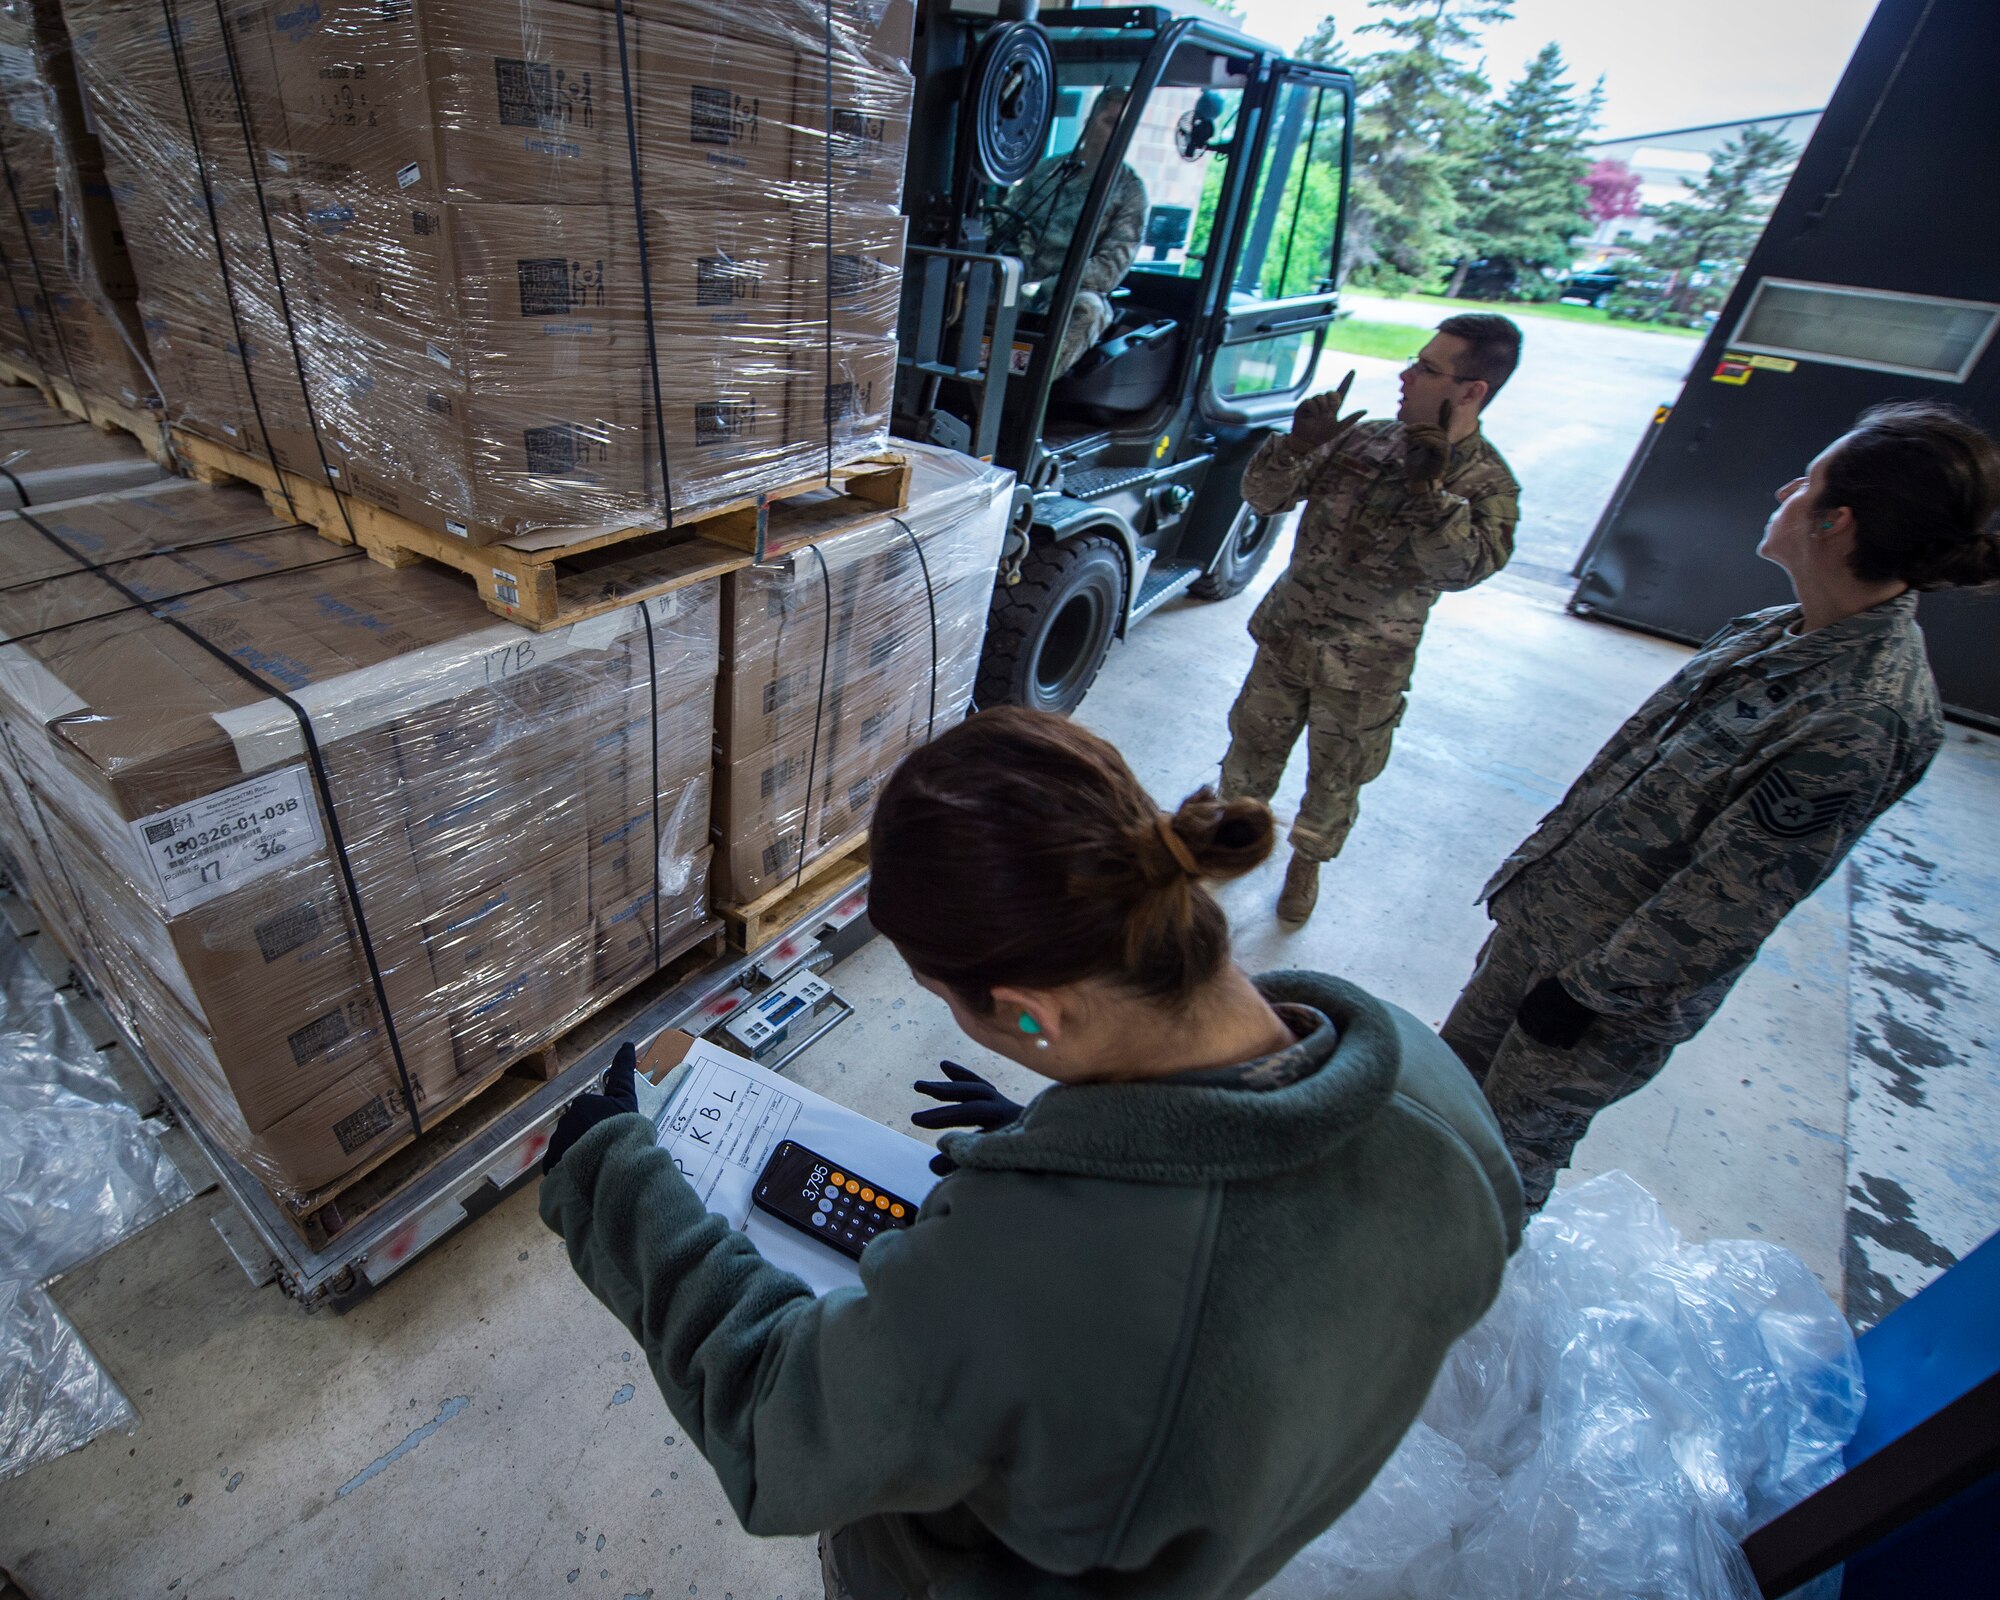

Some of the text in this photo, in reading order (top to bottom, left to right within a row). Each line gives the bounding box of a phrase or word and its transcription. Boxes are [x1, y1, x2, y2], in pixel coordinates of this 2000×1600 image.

[484, 641, 536, 685] 17B
[260, 829, 287, 843] Boxes
[254, 839, 286, 862] 36
[164, 867, 194, 882] Pallet
[201, 860, 221, 883] 17
[672, 1116, 686, 1132] C-5
[802, 1164, 828, 1202] 3,795
[831, 1196, 850, 1231] 7 8 9
[846, 1231, 854, 1239] 4
[858, 1204, 866, 1212] 6
[873, 1212, 880, 1220] 3
